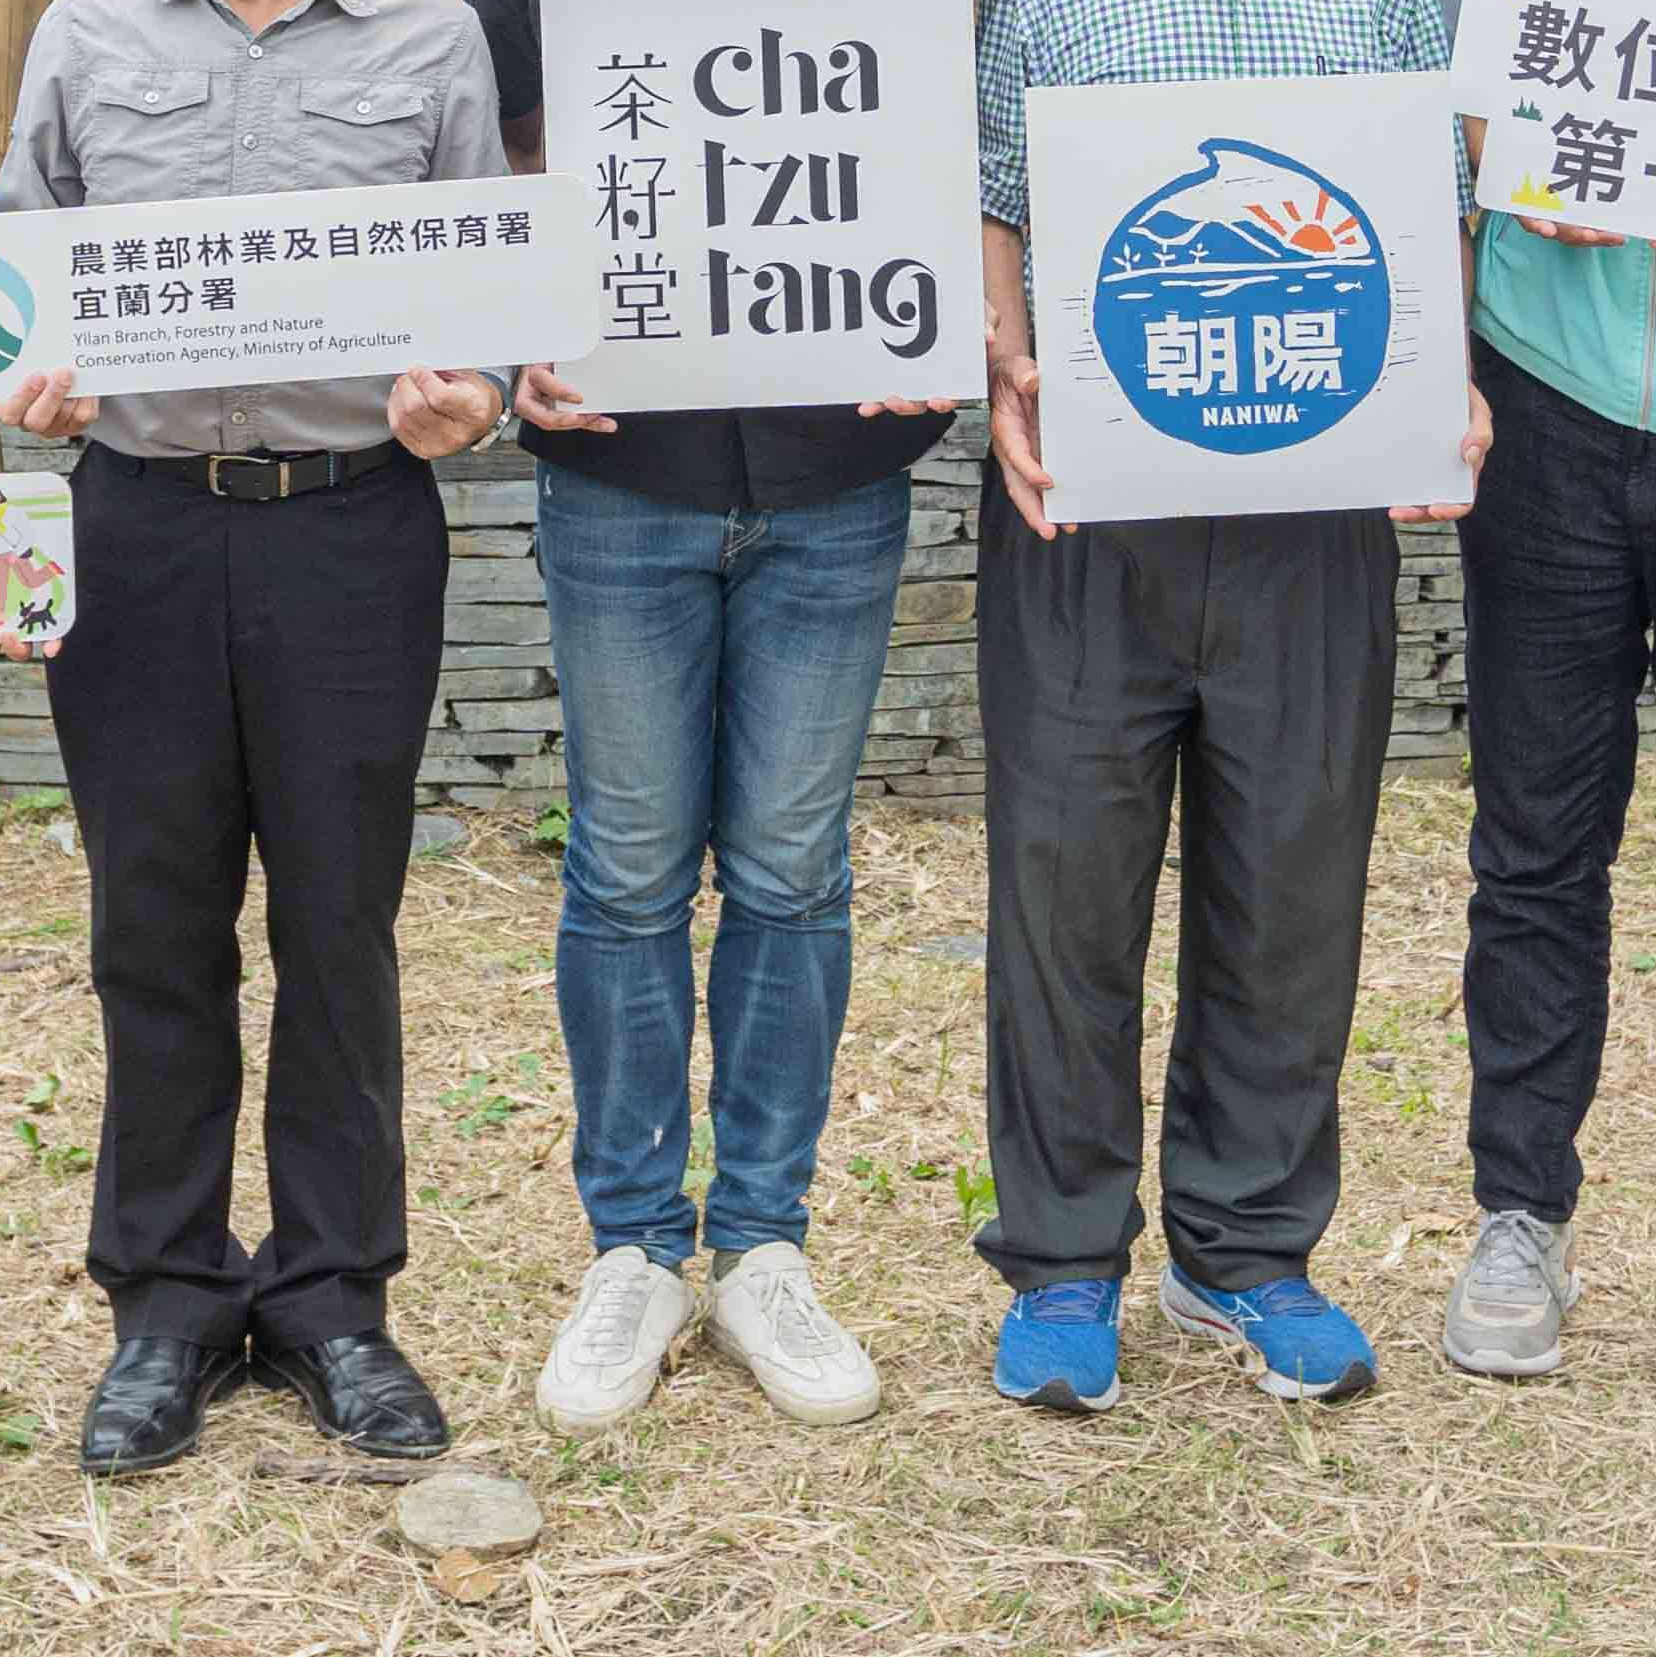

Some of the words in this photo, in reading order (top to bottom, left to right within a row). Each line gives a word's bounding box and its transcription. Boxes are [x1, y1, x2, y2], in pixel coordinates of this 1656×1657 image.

[693, 27, 880, 118] cha
[594, 52, 682, 342] 茶籽堂
[695, 140, 860, 228] tzu
[70, 210, 532, 277] 農業部林業及自然保育署
[73, 277, 237, 320] 宜蘭分署
[73, 330, 110, 345] Yilan
[115, 327, 171, 344] Branch,
[175, 323, 236, 339] Forestry
[240, 320, 268, 335] and
[273, 317, 324, 331] Nature
[700, 249, 938, 359] tang
[75, 349, 176, 368] Conservation
[180, 345, 240, 363] Agency,
[244, 340, 304, 356] Ministry
[309, 336, 324, 351] of
[328, 333, 412, 352] Agriculture
[1144, 310, 1342, 398] 朝陽
[1203, 403, 1300, 427] NANIWA
